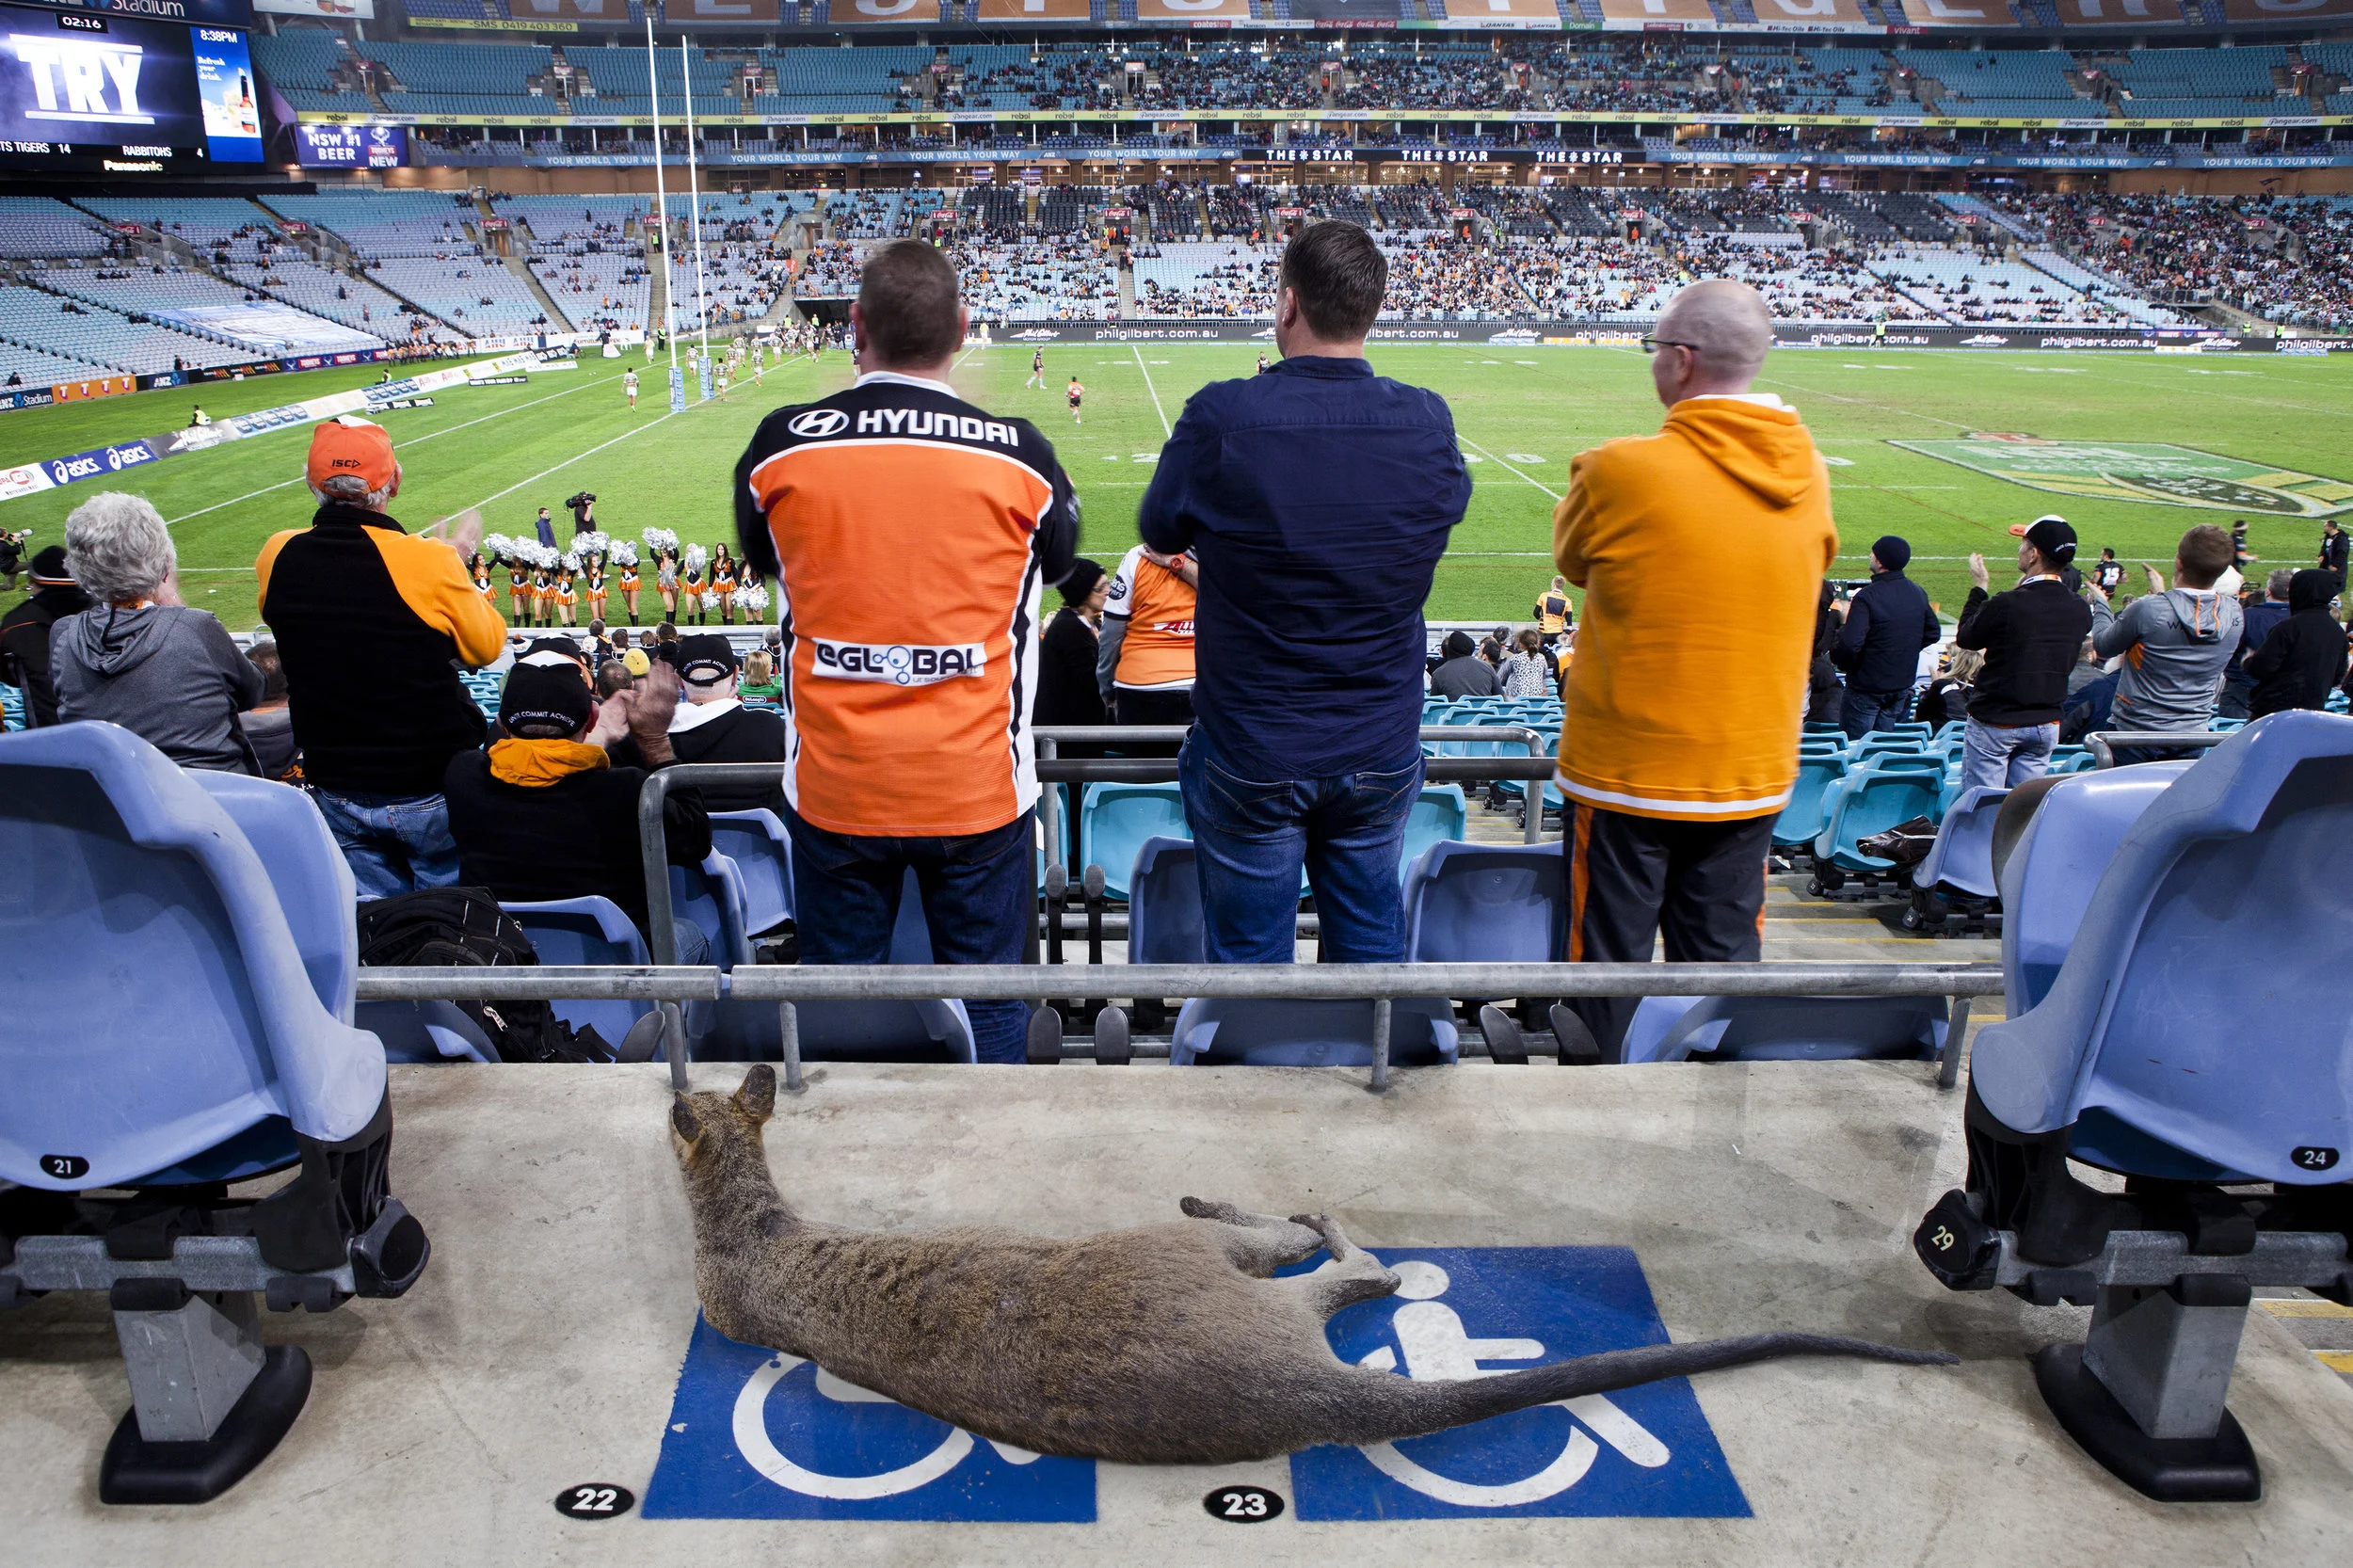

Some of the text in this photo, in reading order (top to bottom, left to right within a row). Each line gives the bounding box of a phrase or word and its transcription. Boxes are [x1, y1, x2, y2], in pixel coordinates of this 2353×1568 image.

[62, 16, 102, 29] 02:16
[530, 22, 550, 30] 403
[552, 23, 573, 31] 360
[200, 29, 238, 43] 8:38PM
[1894, 26, 1921, 35] vivant
[16, 44, 143, 114] TRY
[308, 134, 361, 147] NSW #1
[16, 141, 50, 154] TIGERS
[58, 143, 72, 154] 14
[122, 145, 204, 158] RABBITOHS 4
[317, 148, 356, 161] BEER
[547, 156, 572, 165] YOUR
[614, 156, 639, 165] YOUR
[642, 156, 656, 165] WA
[1266, 150, 1353, 161] THE STAR
[1401, 151, 1488, 162] THE STAR
[1536, 152, 1623, 164] THE STAR
[1670, 152, 1694, 161] YOUR
[1732, 153, 1755, 162] YOUR
[1758, 153, 1778, 162] WAY
[1844, 155, 1868, 164] YOUR
[1905, 156, 1930, 165] YOUR
[1932, 157, 1951, 166] WAY
[103, 159, 164, 172] Panasonic
[369, 156, 399, 167] NEW
[2080, 158, 2105, 167] YOUR
[2202, 158, 2231, 167] YOUR
[2277, 158, 2304, 167] YOUR
[2307, 157, 2334, 166] WAY
[1096, 328, 1219, 340] philgilbert.com.au
[2041, 337, 2158, 348] philgilbert.com.au
[24, 393, 53, 406] Stadium
[856, 408, 1019, 447] HYUNDAI
[331, 459, 351, 468] ISC
[550, 712, 576, 728] ACHIEVE
[2303, 1151, 2327, 1165] 24
[54, 1159, 72, 1175] 21
[1931, 1225, 1954, 1252] 29
[572, 1488, 616, 1512] 22
[1224, 1493, 1267, 1516] 23
